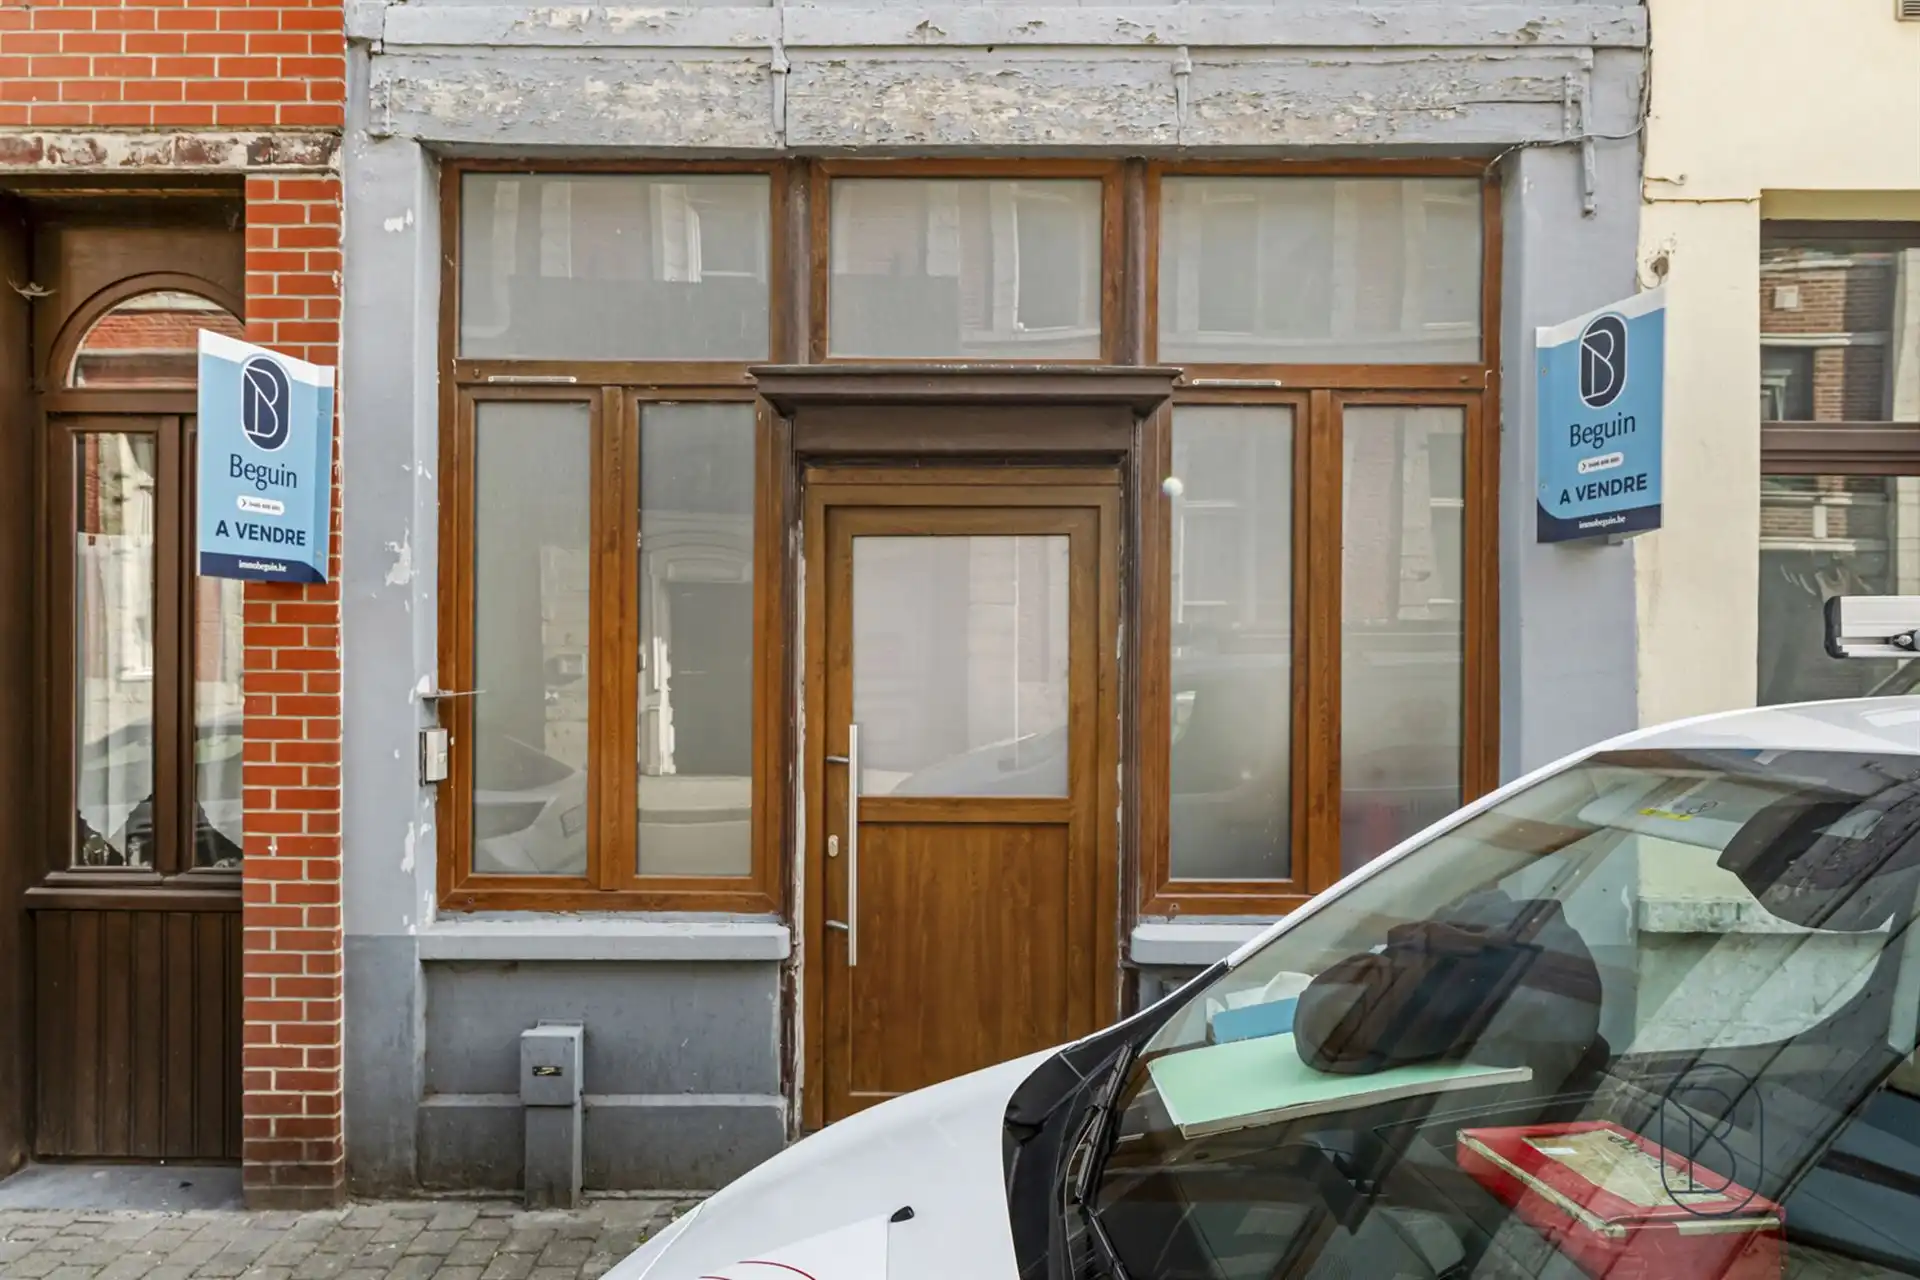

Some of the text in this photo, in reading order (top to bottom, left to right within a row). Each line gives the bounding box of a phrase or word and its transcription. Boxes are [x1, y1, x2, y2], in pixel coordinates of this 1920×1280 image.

[1569, 411, 1636, 450] Beguin
[229, 453, 298, 491] Beguin
[1559, 473, 1648, 506] A VENDRE
[215, 519, 306, 547] A VENDRE
